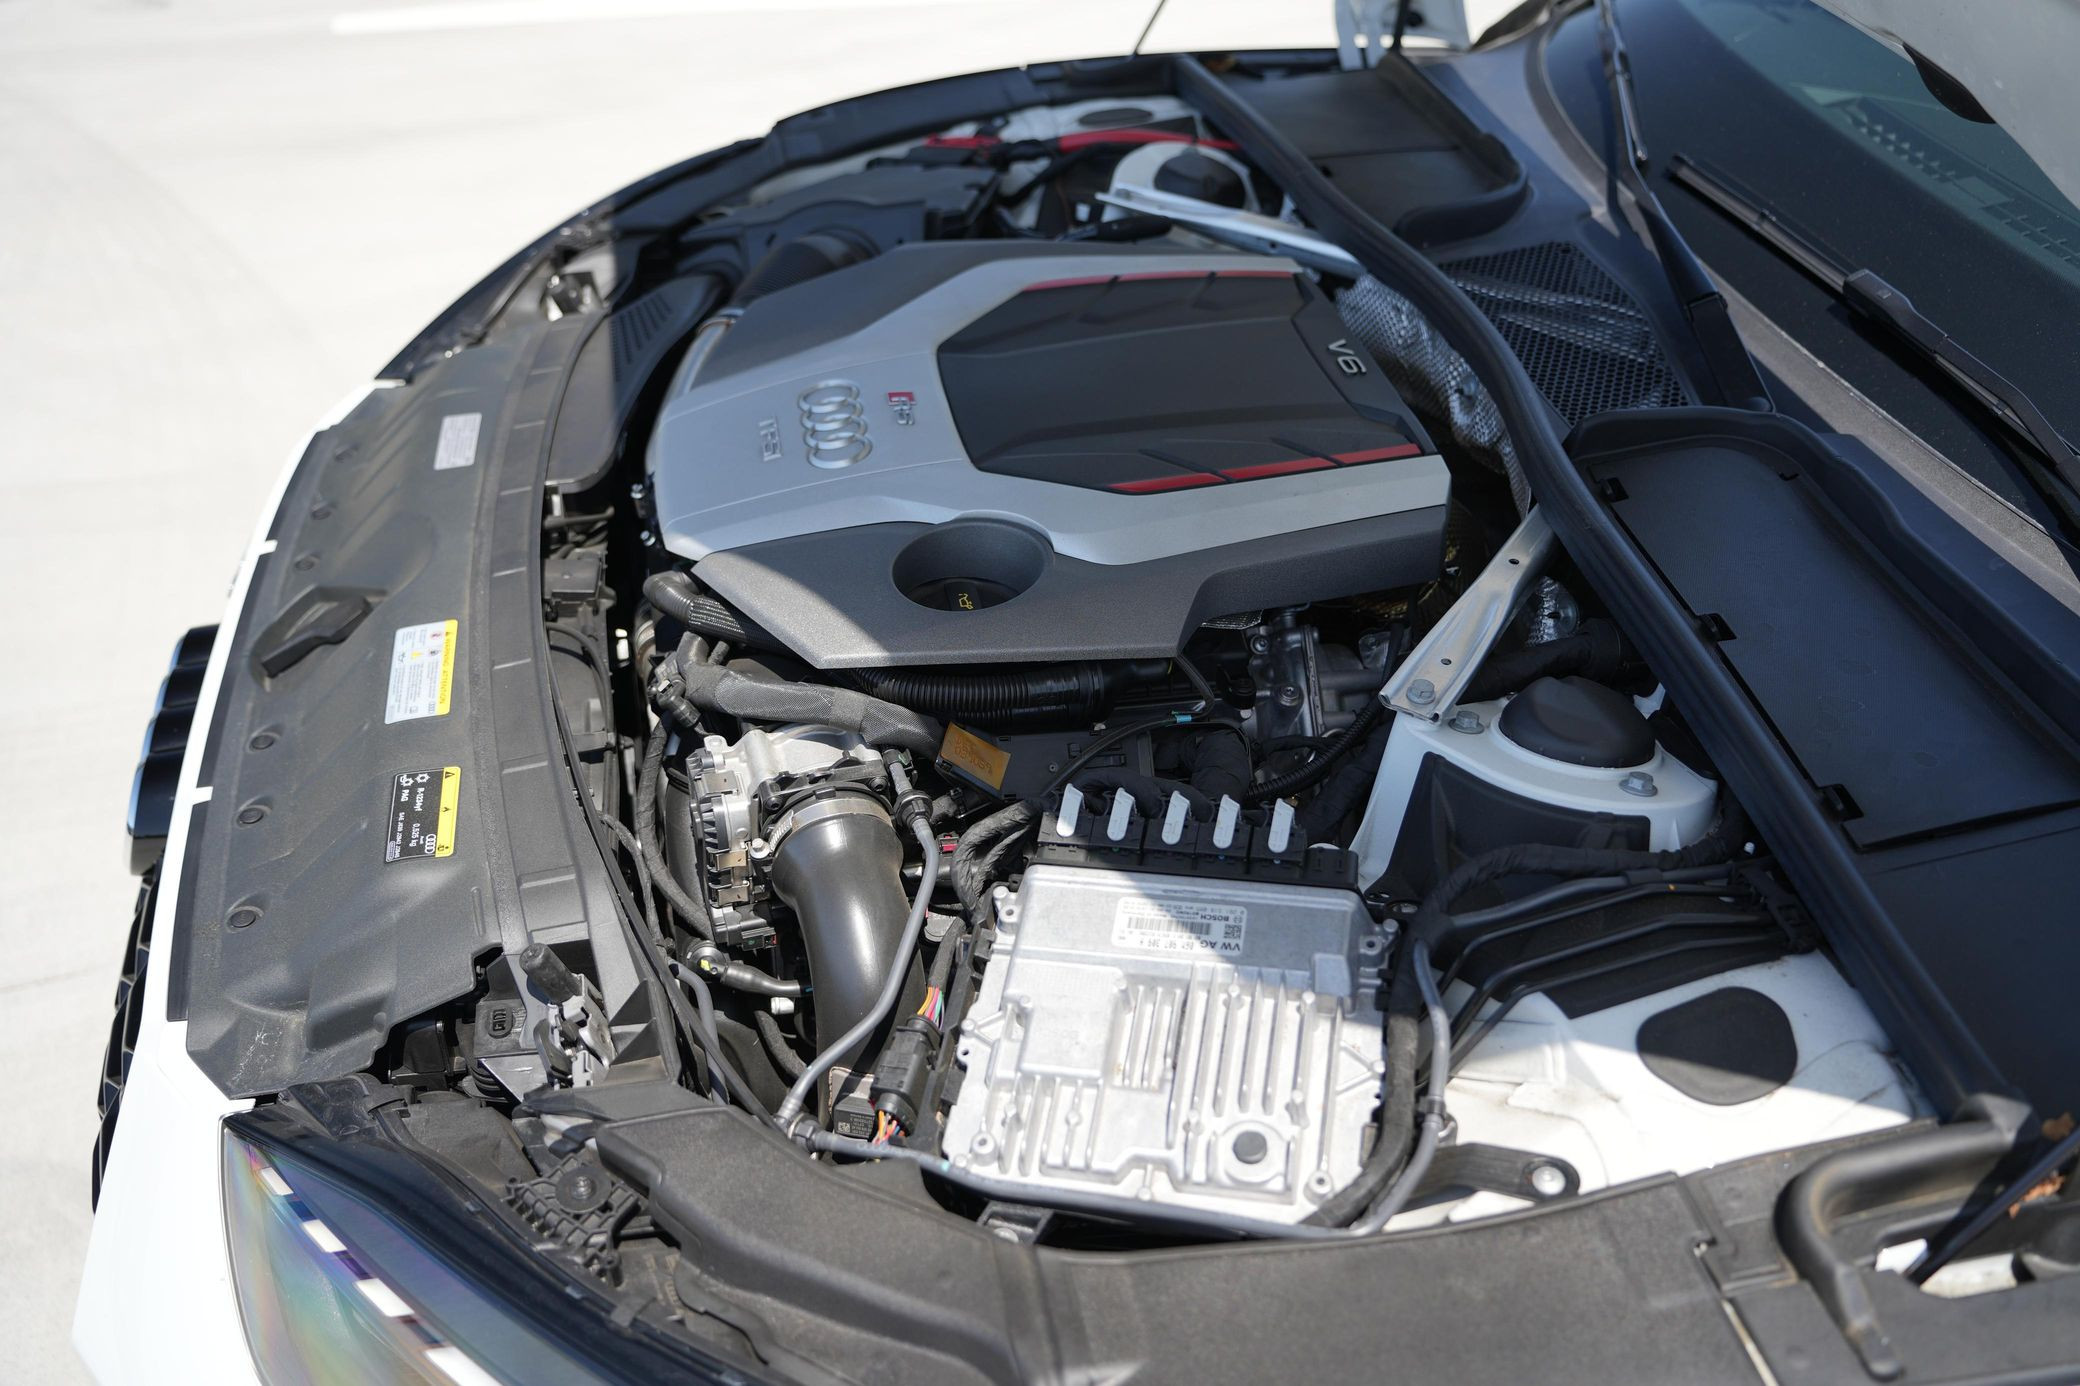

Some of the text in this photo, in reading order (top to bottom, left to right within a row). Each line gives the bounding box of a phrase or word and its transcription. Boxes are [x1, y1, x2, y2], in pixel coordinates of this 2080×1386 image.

[1328, 339, 1367, 374] V6
[758, 417, 784, 463] TFSI
[439, 638, 451, 704] WARNING ATTENTION
[400, 789, 410, 802] PAG
[409, 839, 419, 847] kg
[1200, 914, 1230, 922] BOSCH
[1199, 939, 1217, 949] AG
[1220, 942, 1241, 952] VW
